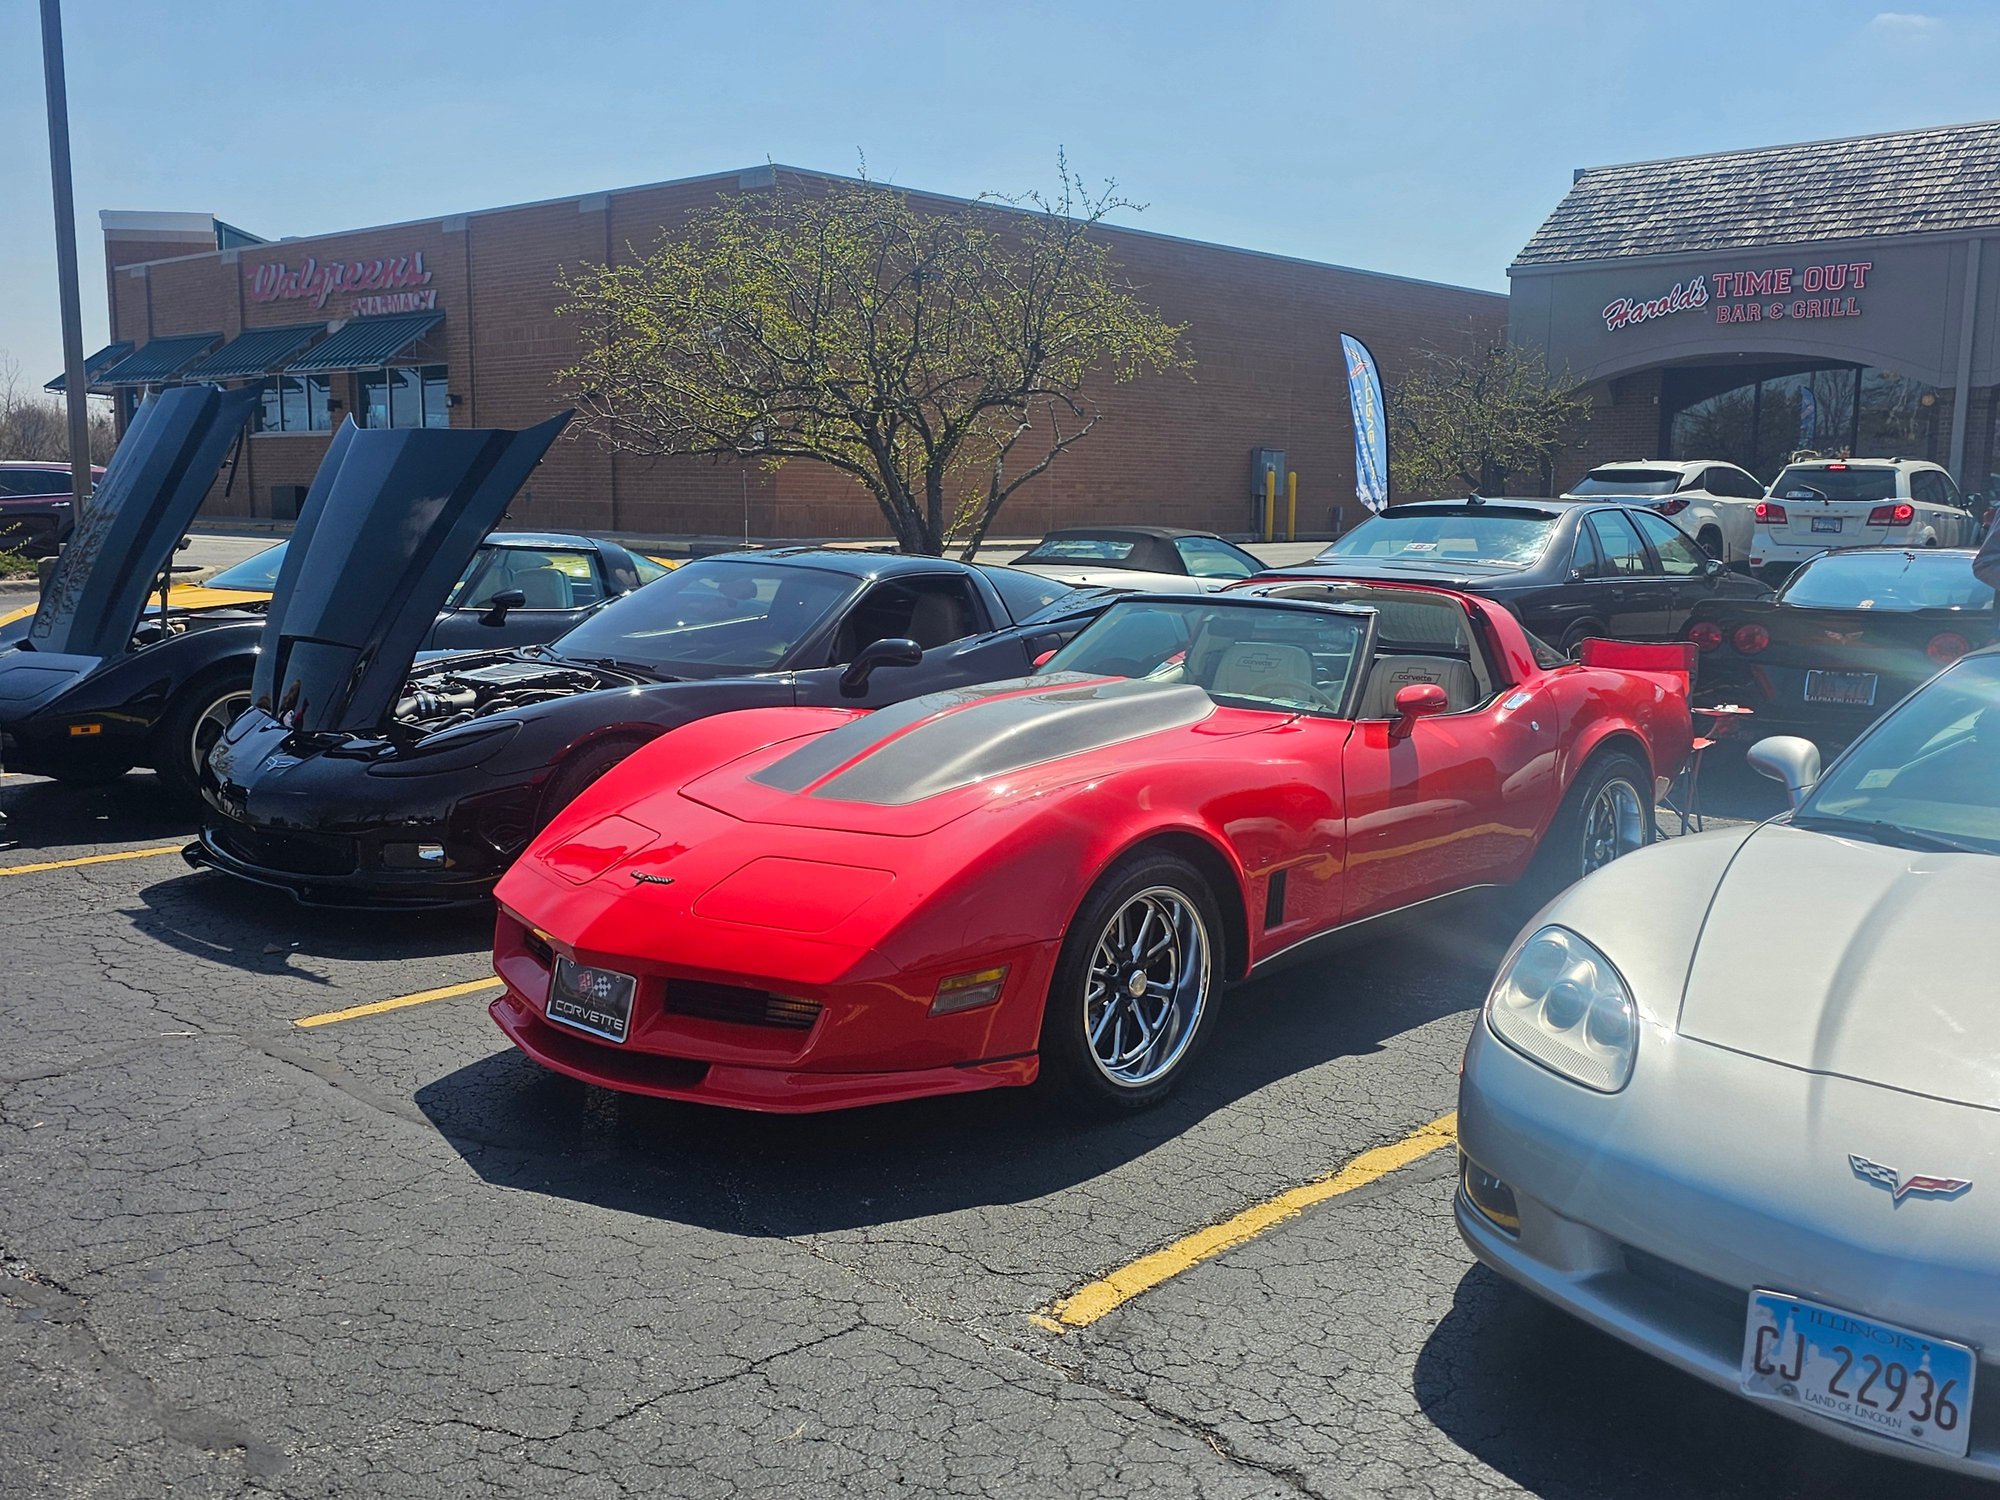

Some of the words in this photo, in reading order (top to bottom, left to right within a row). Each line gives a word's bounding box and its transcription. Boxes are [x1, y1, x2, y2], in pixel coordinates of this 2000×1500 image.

[246, 251, 432, 310] Walgreens
[1712, 268, 1793, 298] TIME
[1803, 262, 1872, 292] OUT
[352, 289, 437, 316] PHARMACY
[1602, 275, 1710, 331] Harold's
[1716, 303, 1761, 324] BAR
[1769, 302, 1784, 319] &
[1791, 297, 1861, 319] GRILL
[1398, 674, 1432, 682] corvette
[555, 1000, 624, 1031] CORVETTE
[1809, 1310, 1916, 1352] ILLINOIS
[1754, 1325, 1805, 1381] CJ
[1828, 1345, 1958, 1431] 22936
[1804, 1388, 1836, 1409] LAND
[1838, 1400, 1852, 1412] OF
[1854, 1404, 1902, 1429] LINCOLN
